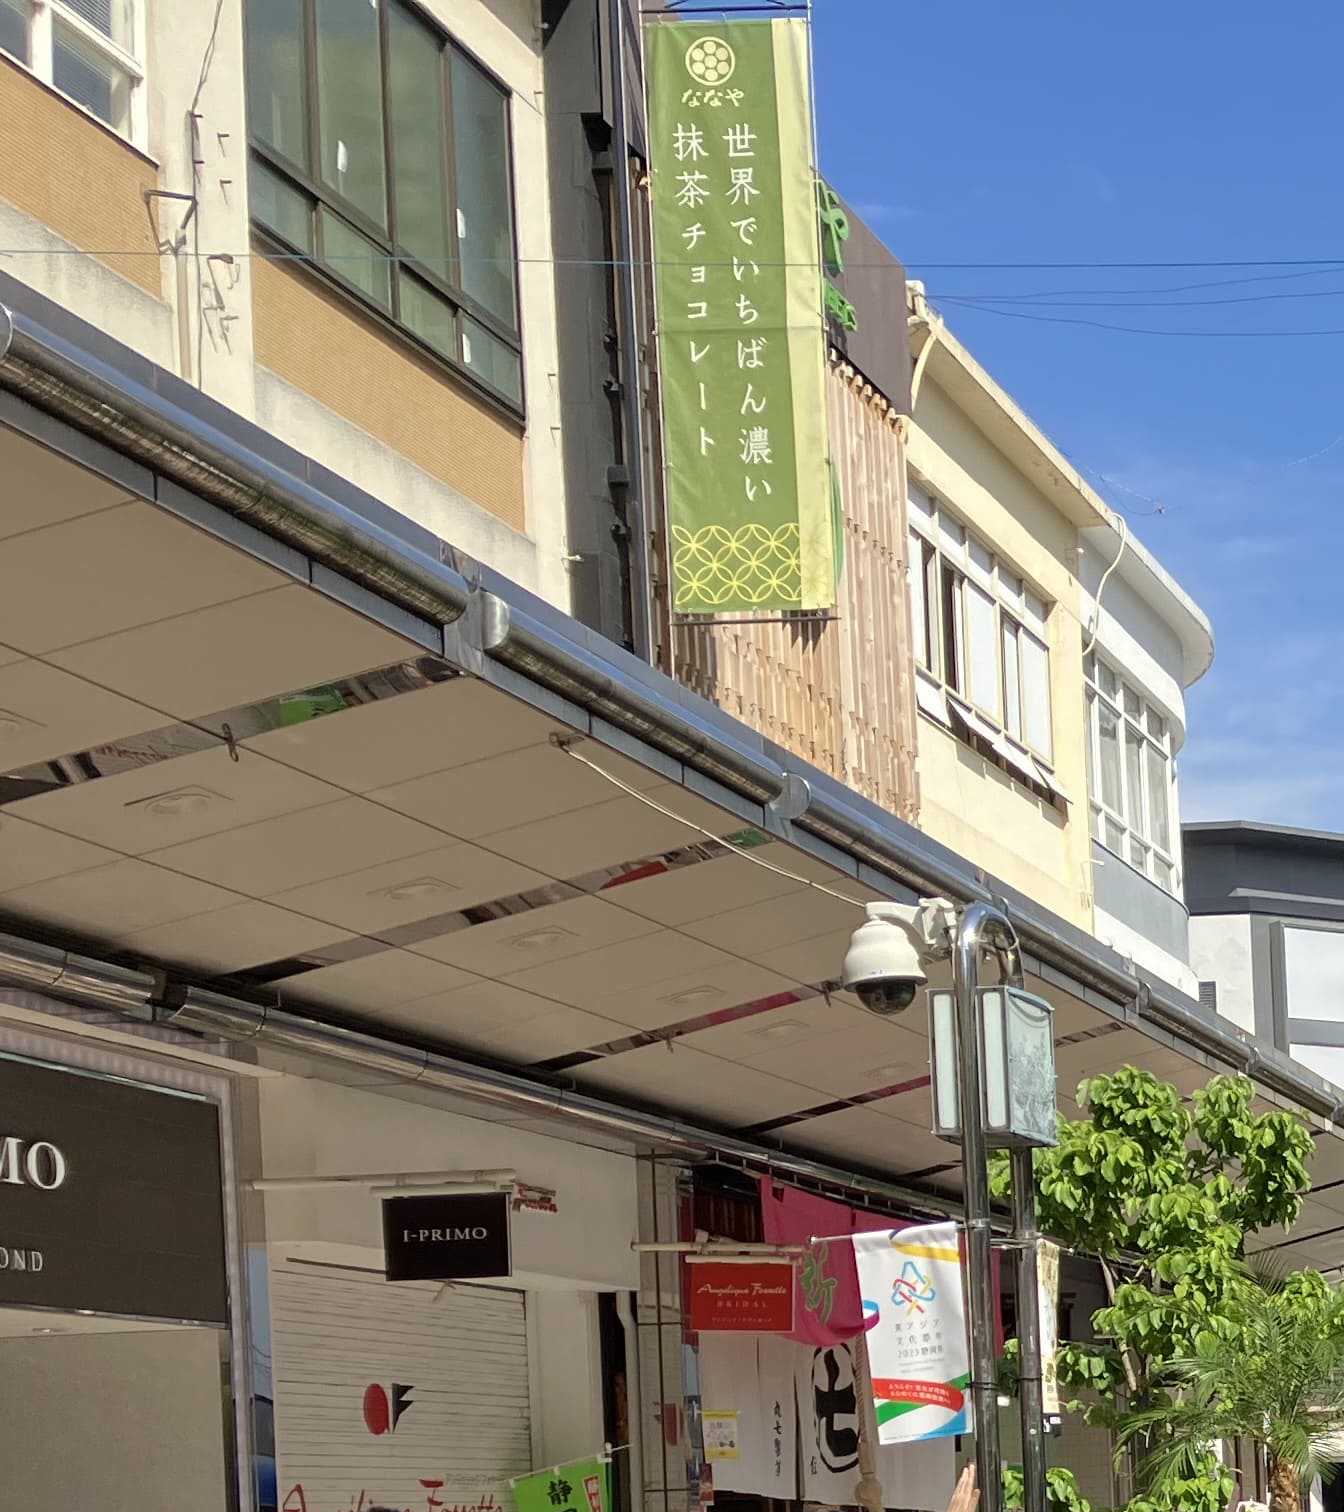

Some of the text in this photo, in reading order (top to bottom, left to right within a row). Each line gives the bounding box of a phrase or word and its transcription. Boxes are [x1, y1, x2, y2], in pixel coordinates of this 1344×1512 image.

[681, 88, 745, 108] ななや
[673, 123, 716, 457] 抹茶チョコレート
[721, 122, 774, 502] 世界でいちばん濃い
[402, 1227, 488, 1243] I-PRIMO
